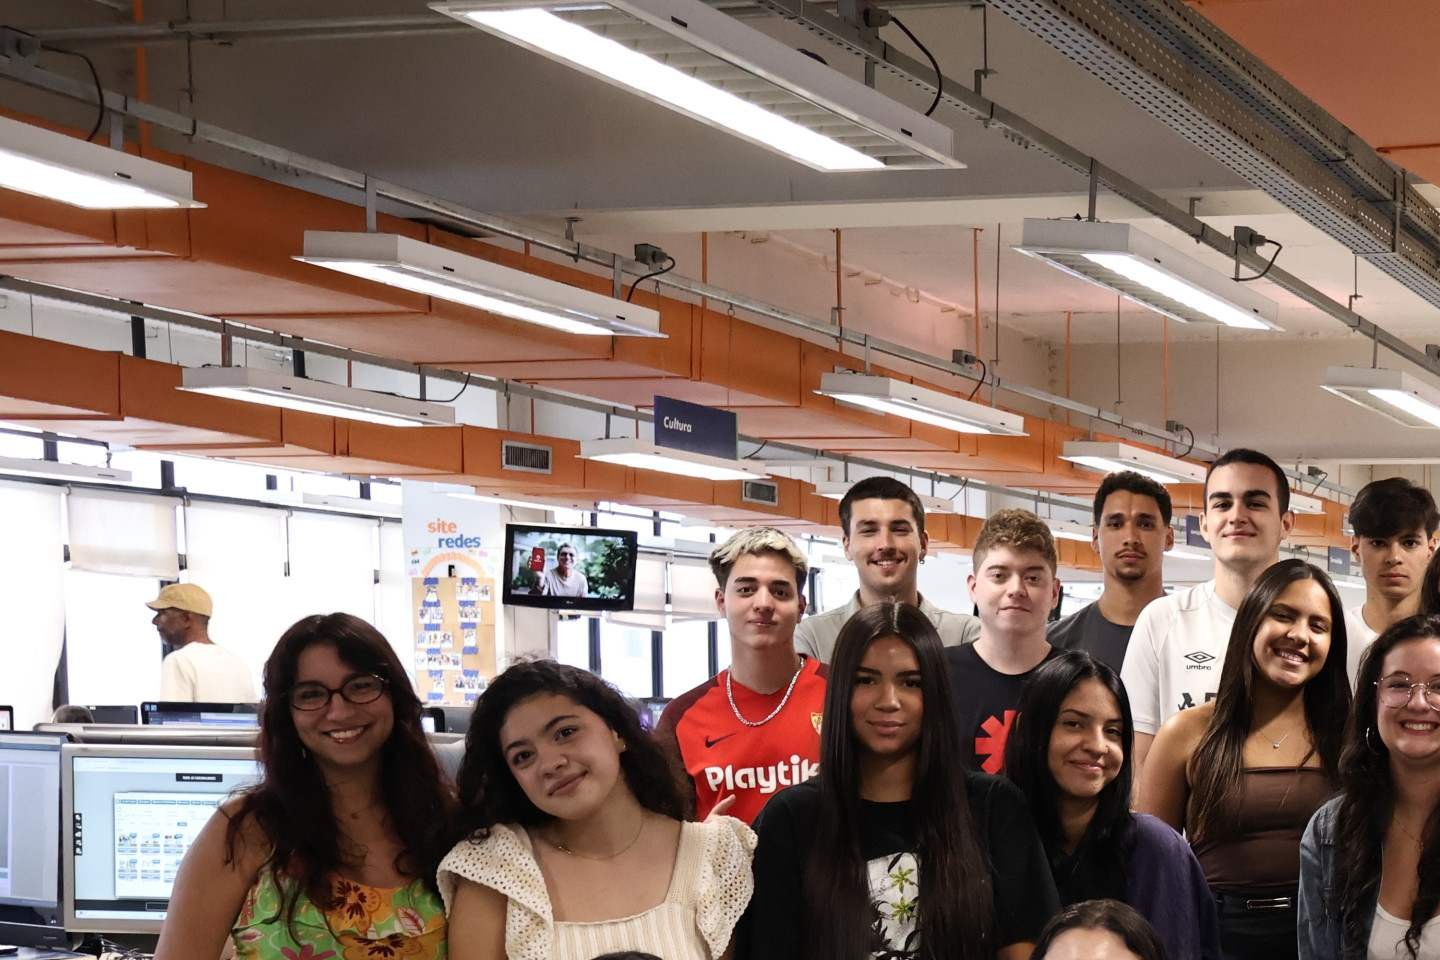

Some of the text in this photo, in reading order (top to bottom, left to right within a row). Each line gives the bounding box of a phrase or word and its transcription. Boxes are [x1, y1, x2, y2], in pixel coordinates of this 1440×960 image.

[663, 415, 692, 433] Cultura
[427, 517, 457, 534] site
[438, 534, 481, 548] redes
